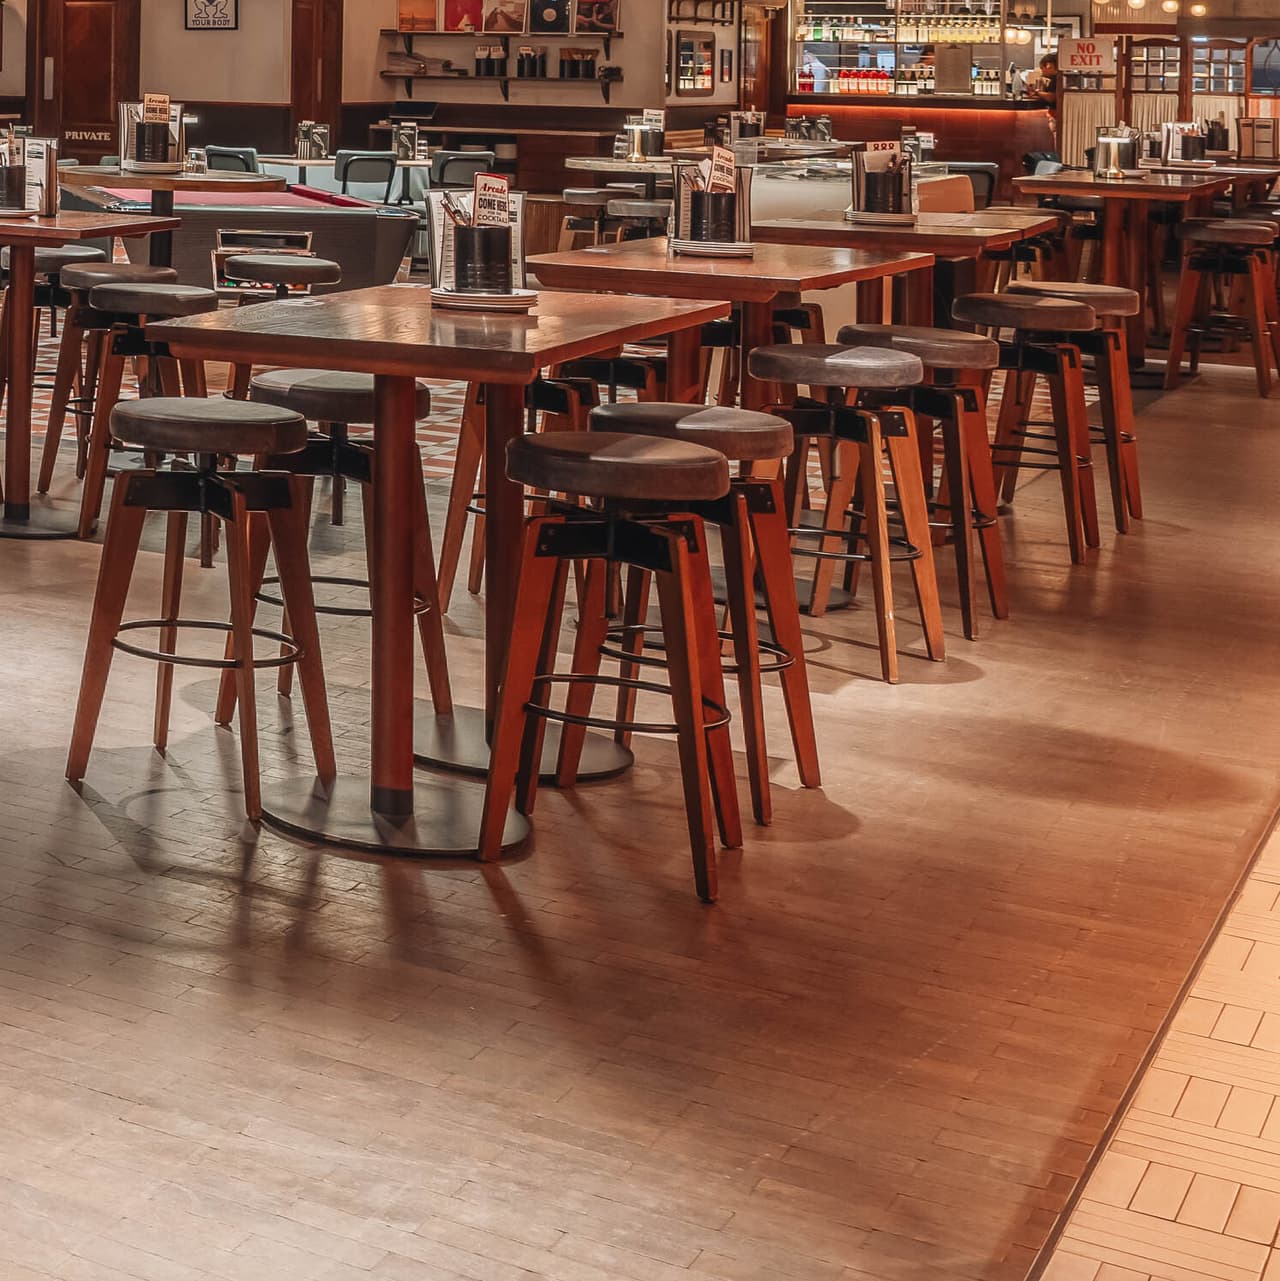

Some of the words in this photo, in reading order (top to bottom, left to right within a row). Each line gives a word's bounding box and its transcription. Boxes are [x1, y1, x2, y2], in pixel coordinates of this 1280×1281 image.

[1076, 42, 1096, 54] NO
[1070, 54, 1103, 66] EXIT
[64, 131, 112, 141] PRIVATE
[480, 183, 506, 195] Arcade
[478, 197, 496, 211] COME
